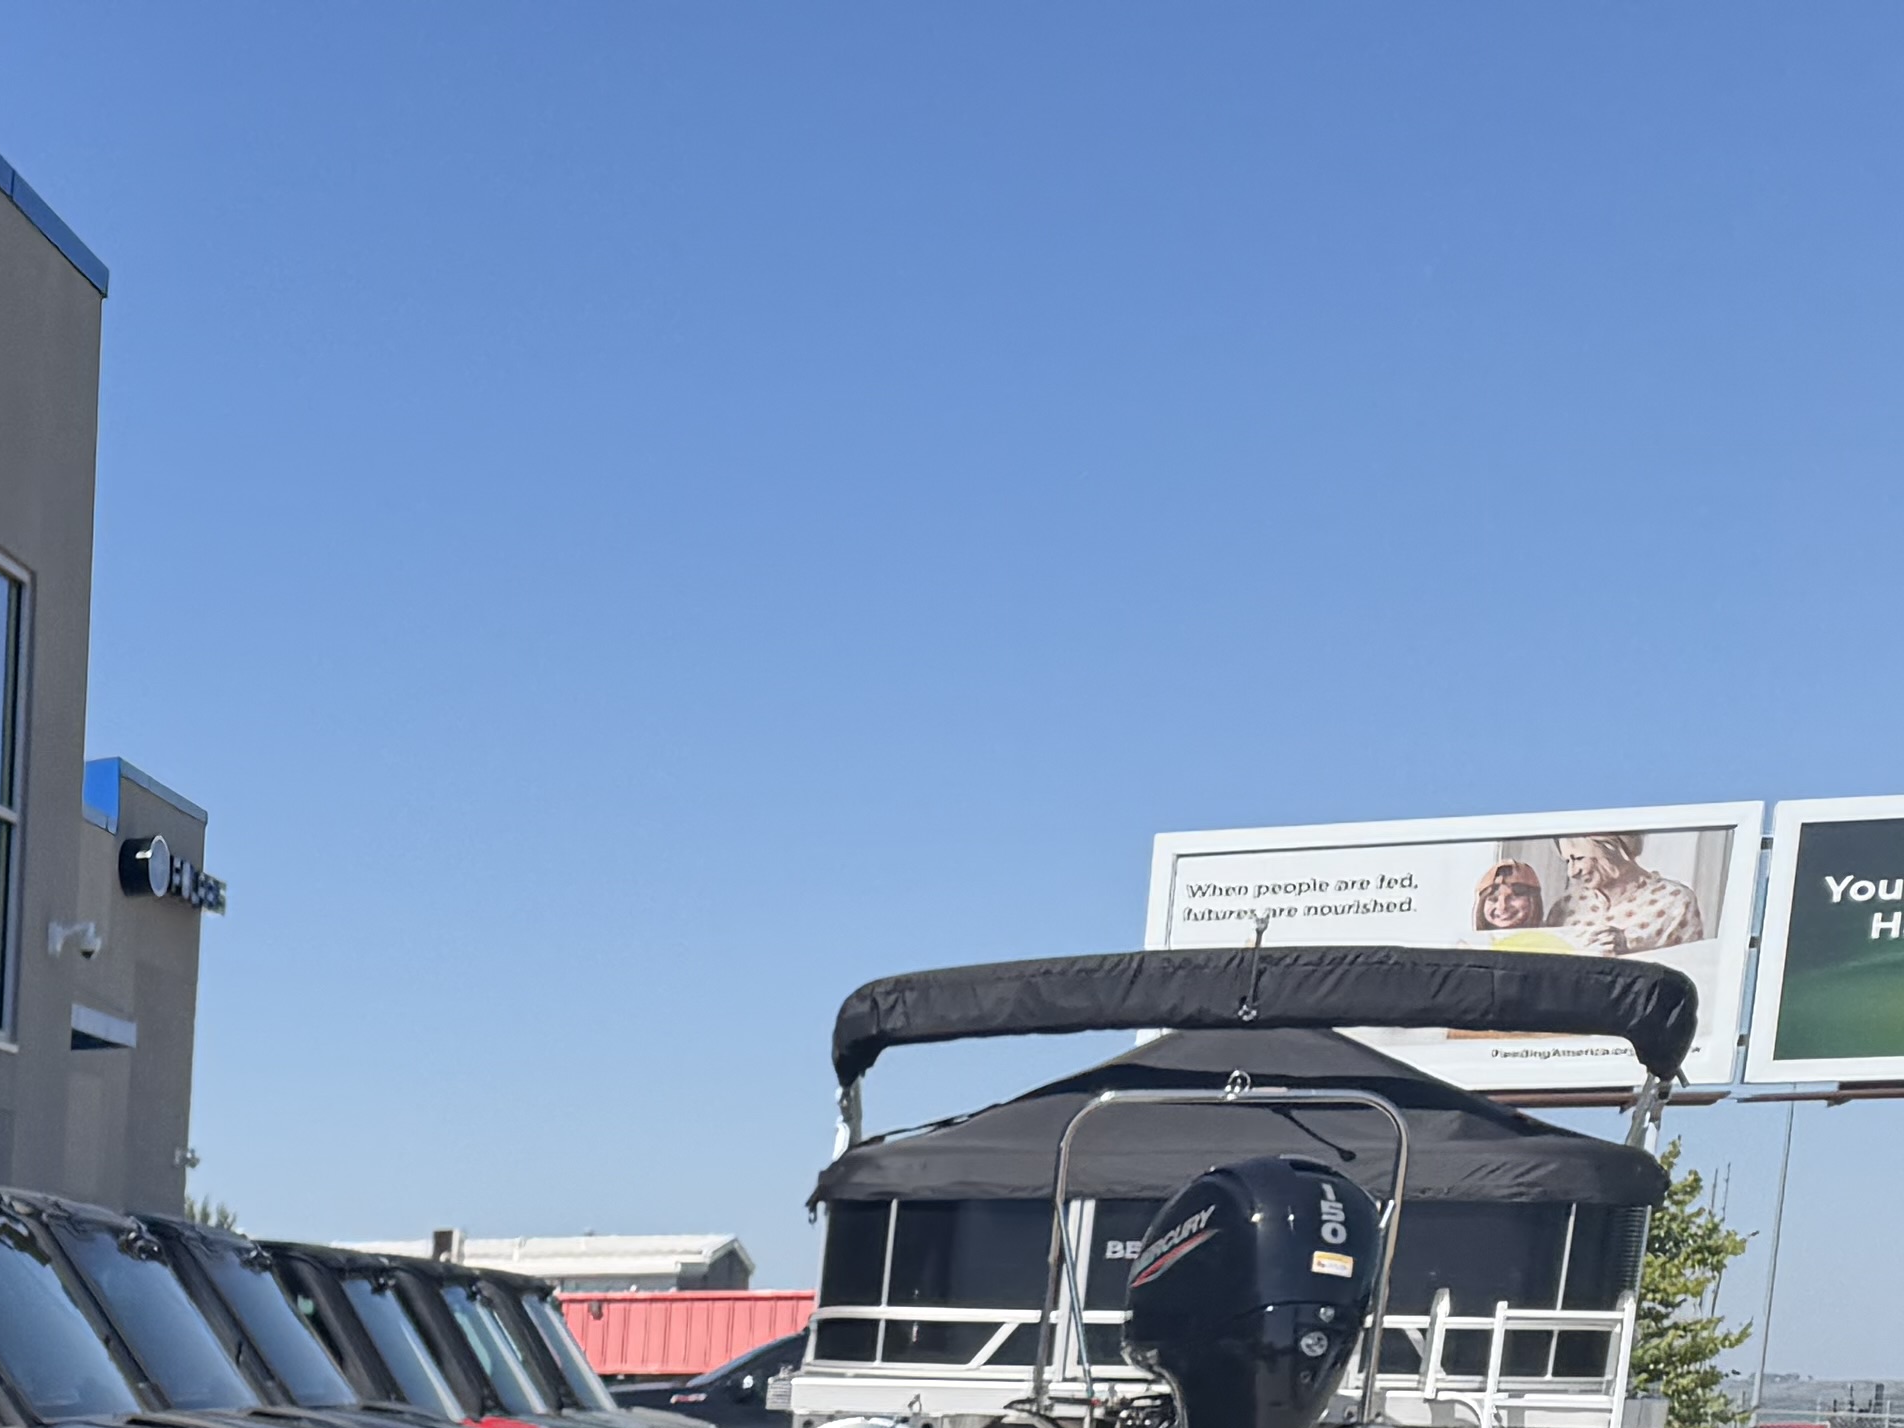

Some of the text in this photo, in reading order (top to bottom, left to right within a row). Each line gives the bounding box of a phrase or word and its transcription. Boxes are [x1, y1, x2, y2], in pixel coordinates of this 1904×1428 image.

[1186, 883, 1249, 899] When
[1253, 877, 1330, 899] people
[1334, 880, 1371, 892] are
[1182, 897, 1418, 922] futures are nourished.
[1871, 911, 1904, 939] H
[1320, 1183, 1347, 1245] 150
